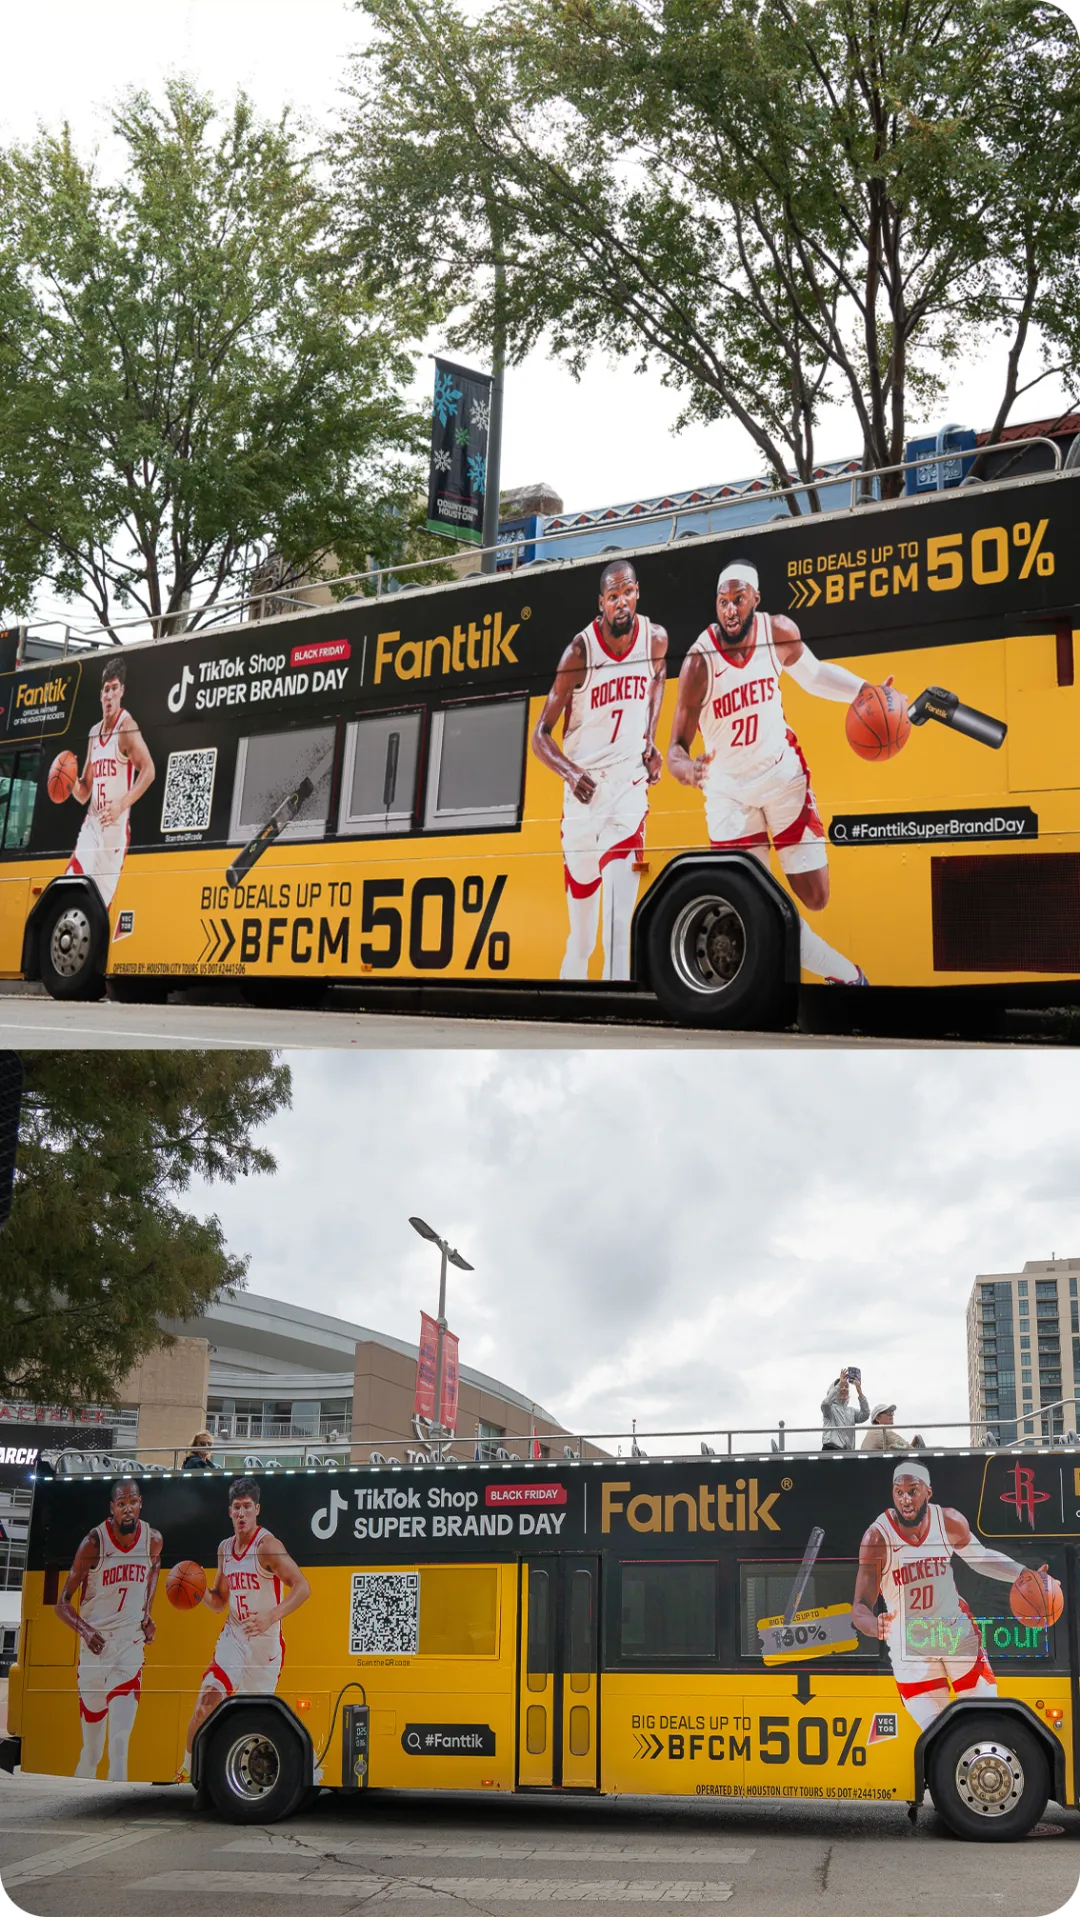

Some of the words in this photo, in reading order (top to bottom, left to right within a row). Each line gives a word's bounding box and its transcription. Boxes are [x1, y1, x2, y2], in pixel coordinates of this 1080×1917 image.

[437, 499, 478, 516] DOWNTOWN
[438, 507, 474, 521] HOUSTON
[788, 558, 813, 577] BIG
[817, 550, 867, 572] DEALS
[871, 545, 893, 564] UP
[897, 541, 918, 559] TO
[926, 518, 1055, 592] 50%
[826, 562, 918, 604] BFCM
[294, 649, 318, 661] BLACK
[319, 645, 345, 657] FRIDAY
[199, 656, 246, 683] TikTok
[248, 654, 286, 674] Shop
[195, 683, 246, 710] SUPER
[250, 673, 309, 702] BRAND
[312, 667, 349, 693] DAY
[591, 675, 647, 710] ROCKETS
[712, 677, 775, 719] ROCKETS
[610, 709, 623, 744] 7
[730, 713, 759, 747] 20
[97, 783, 106, 810] 15
[851, 817, 1026, 838] #FanttikSuperBrandDay
[201, 885, 229, 910] BIG
[233, 884, 291, 909] DEALS
[296, 883, 322, 908] UP
[328, 882, 352, 907] TO
[360, 874, 510, 970] 50%
[240, 916, 350, 964] BFCM
[113, 963, 137, 974] OPERATED
[147, 963, 169, 974] HOUSTON
[170, 963, 181, 974] CITY
[182, 963, 198, 974] TOURS
[200, 964, 207, 974] US
[207, 964, 218, 974] DOT
[219, 964, 246, 975] #2441506
[354, 1488, 421, 1510] TikTok
[427, 1487, 478, 1512] Shop
[490, 1490, 522, 1500] BLACK
[524, 1489, 559, 1500] FRIDAY
[353, 1516, 426, 1539] SUPER
[432, 1513, 513, 1538] BRAND
[519, 1512, 566, 1536] DAY
[102, 1563, 147, 1587] ROCKETS
[892, 1556, 947, 1587] ROCKETS
[117, 1588, 128, 1612] 7
[235, 1595, 249, 1621] 15
[909, 1585, 934, 1610] 20
[906, 1619, 963, 1655] City
[973, 1619, 1044, 1648] Tour
[357, 1658, 373, 1667] Scan
[373, 1658, 384, 1667] the
[385, 1658, 395, 1667] QR
[395, 1658, 411, 1667] code
[631, 1715, 655, 1729] BIG
[660, 1715, 705, 1730] DEALS
[709, 1716, 729, 1731] UP
[735, 1716, 751, 1731] TO
[878, 1725, 894, 1733] TOR
[425, 1733, 483, 1748] #Fanttik
[668, 1733, 751, 1761] BFCM
[759, 1716, 867, 1767] 50%
[696, 1785, 732, 1796] OPERATED
[733, 1786, 744, 1797] BY:
[747, 1786, 781, 1797] HOUSTON
[782, 1786, 798, 1797] CITY
[800, 1786, 824, 1797] TOURS
[826, 1787, 836, 1798] US
[837, 1787, 852, 1798] DOT
[852, 1788, 891, 1800] #2441506
